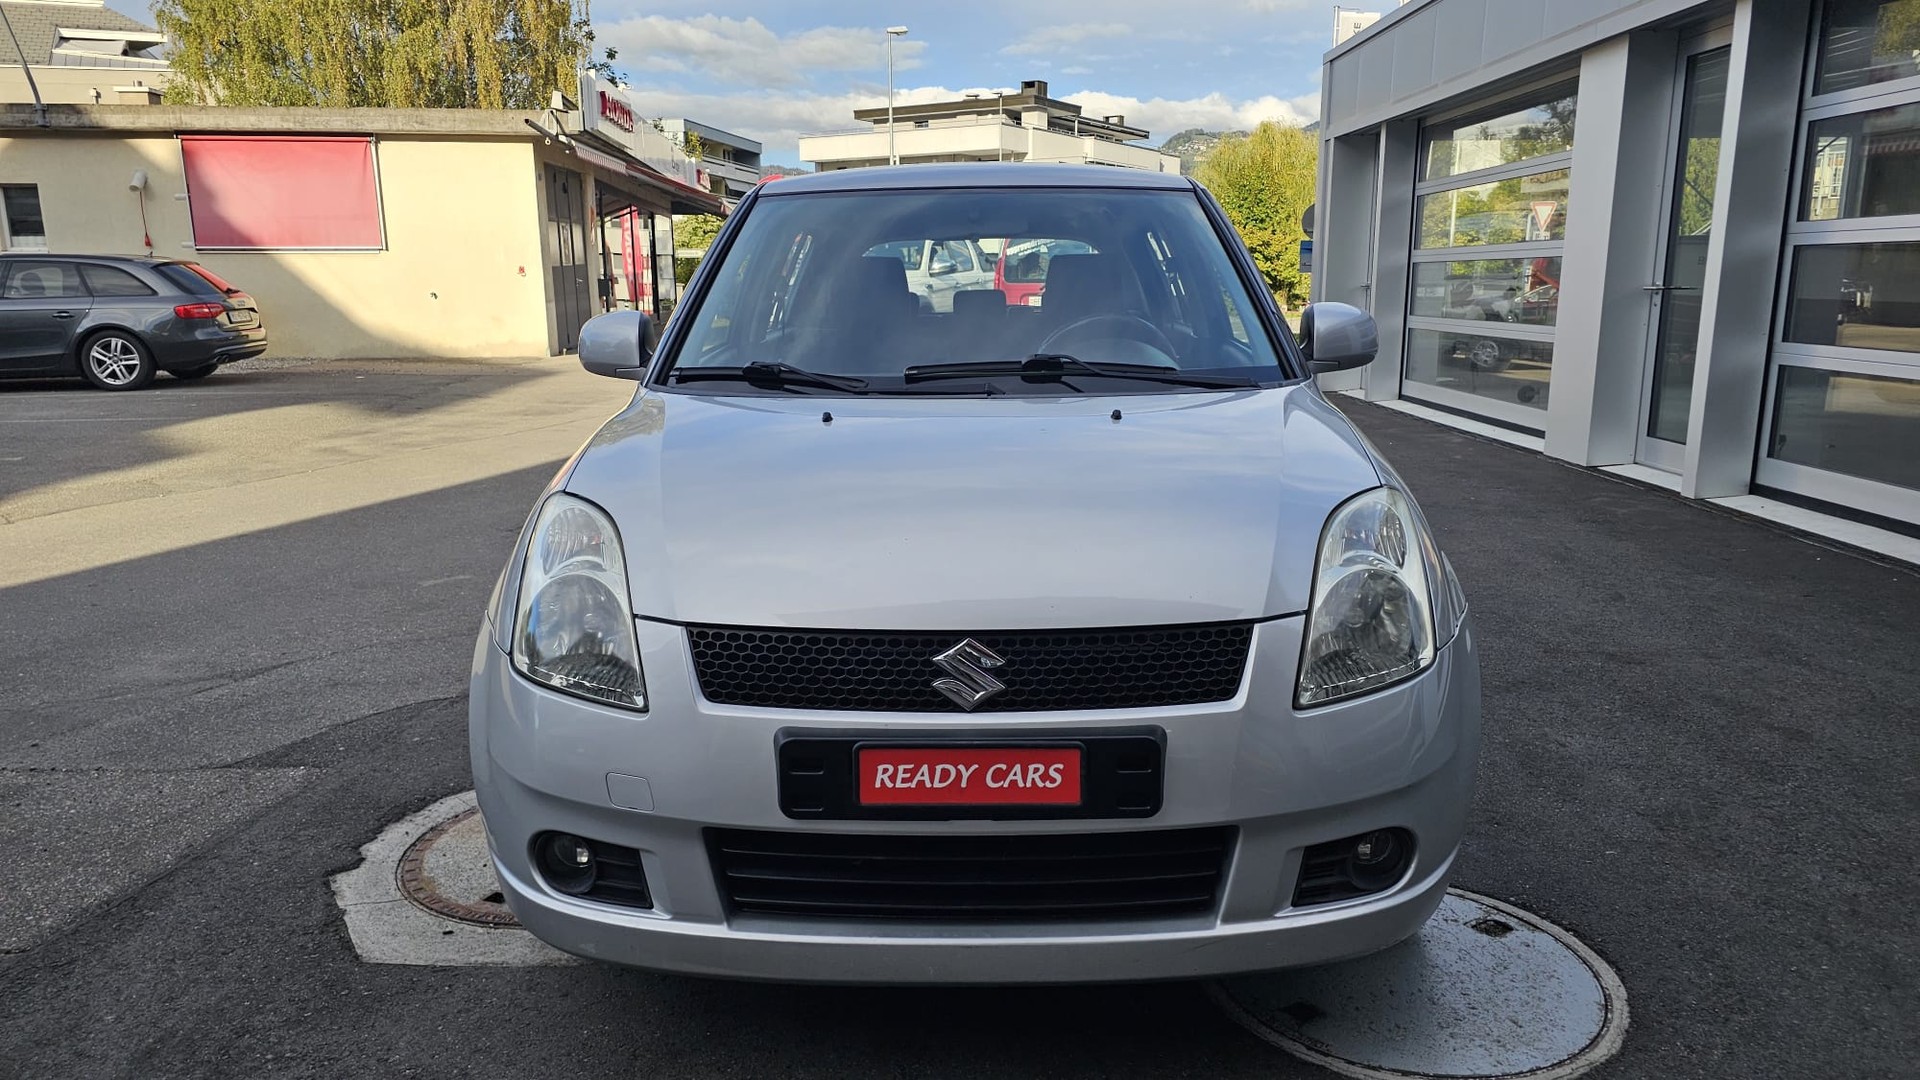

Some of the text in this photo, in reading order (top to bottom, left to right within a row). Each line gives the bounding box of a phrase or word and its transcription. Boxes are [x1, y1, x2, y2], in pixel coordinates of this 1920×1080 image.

[600, 91, 635, 132] HONDA
[874, 763, 1064, 788] READY CARS
